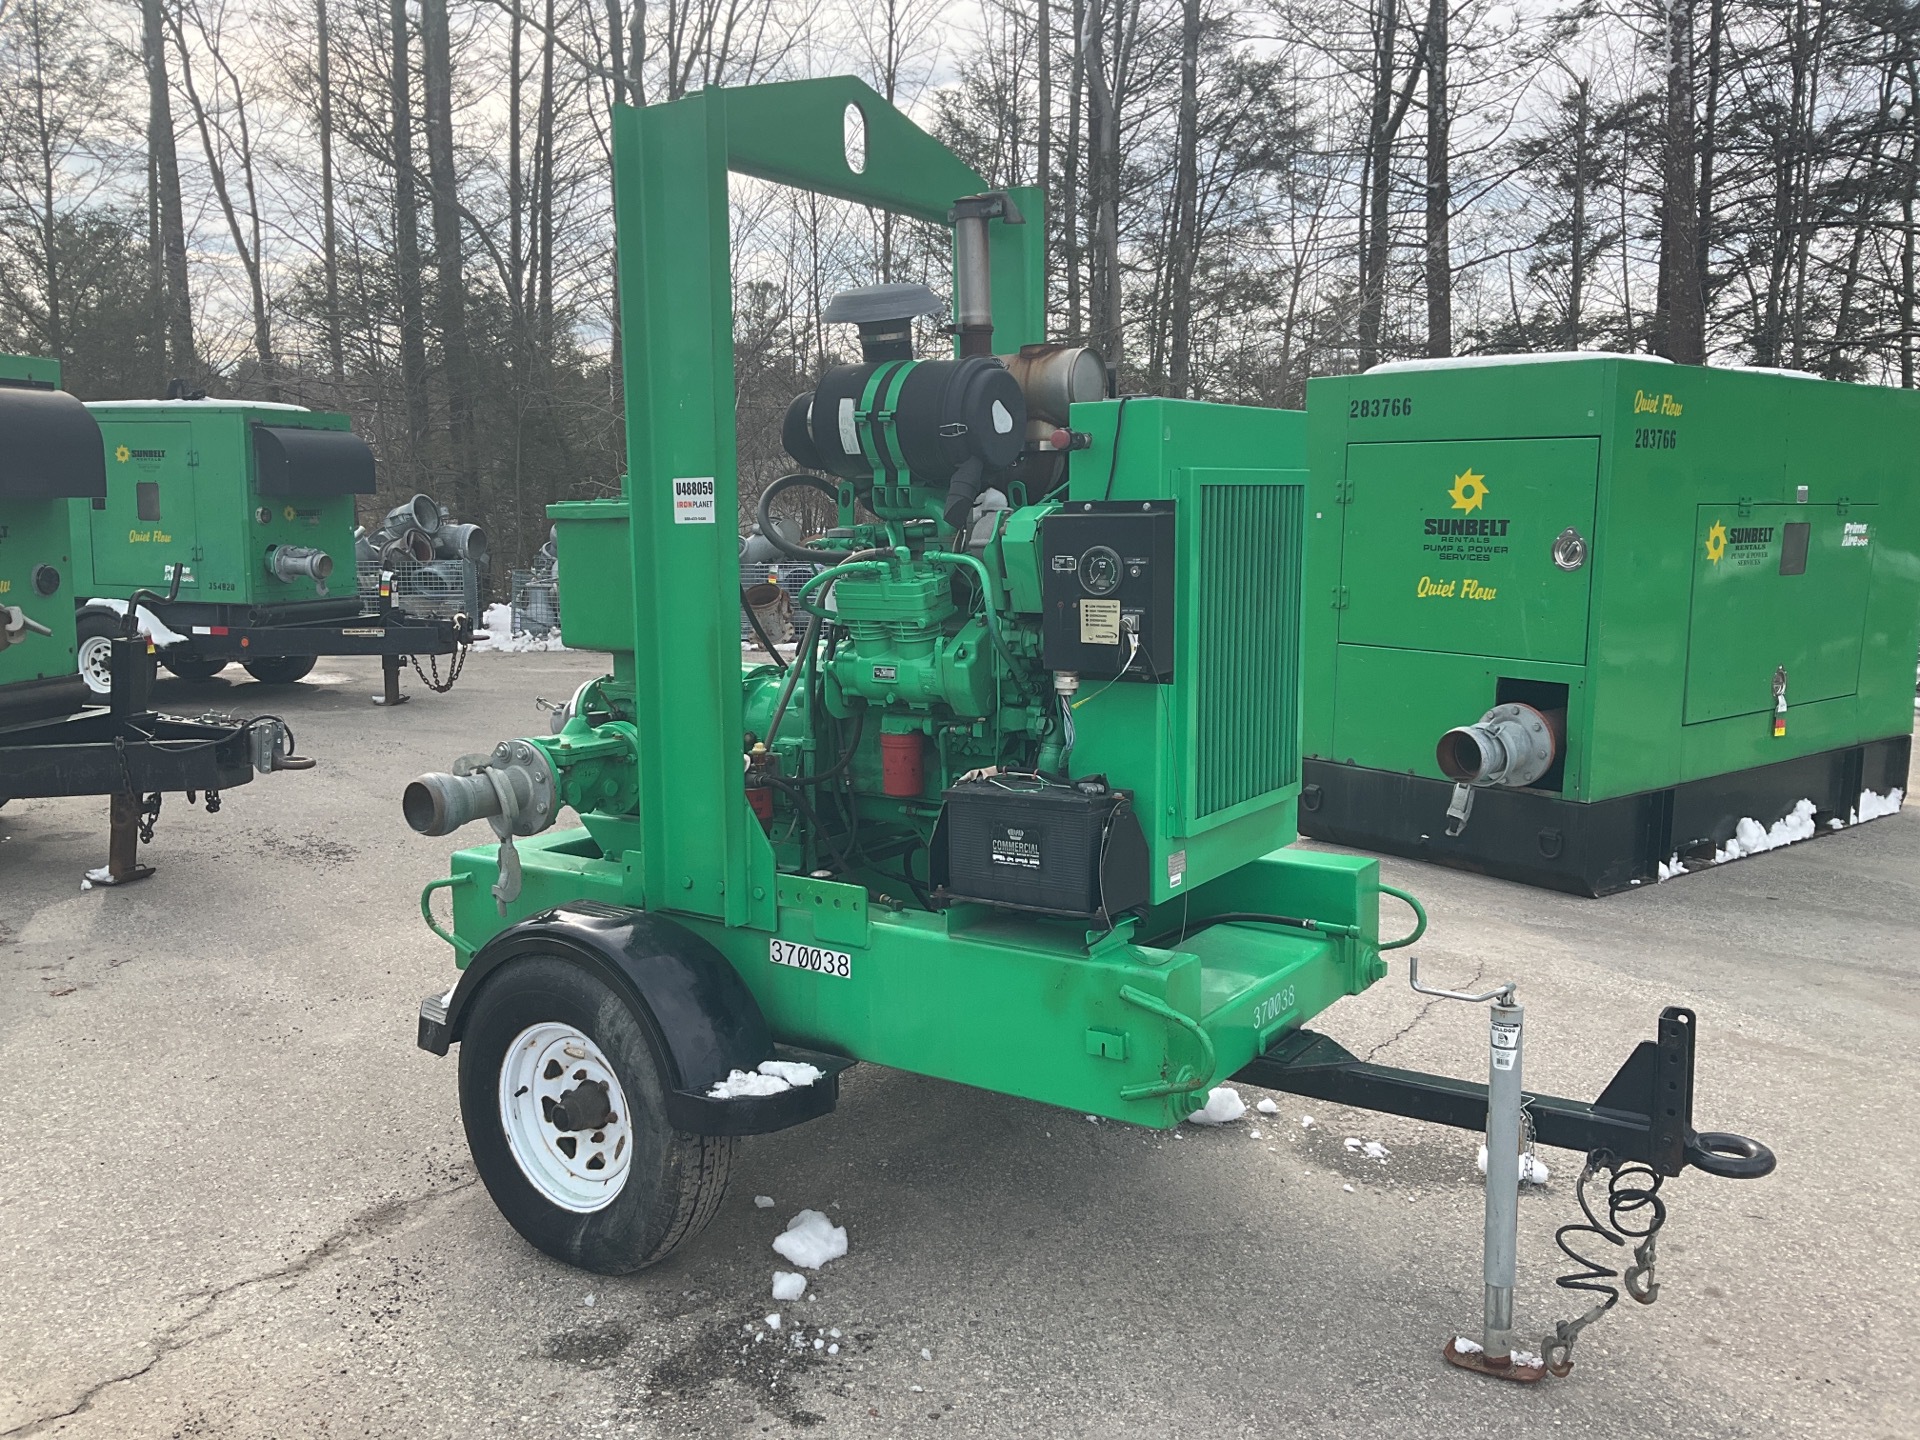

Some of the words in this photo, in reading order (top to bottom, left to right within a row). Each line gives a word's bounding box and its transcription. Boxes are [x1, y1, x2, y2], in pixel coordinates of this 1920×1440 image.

[1349, 397, 1412, 418] 283766
[1633, 389, 1660, 414] Quiet
[1660, 393, 1683, 417] Flow
[1635, 428, 1677, 450] 283766
[131, 449, 166, 458] SUNBELT
[675, 481, 714, 496] U488059
[1423, 518, 1511, 537] SUNBELT
[1729, 527, 1775, 544] SUNBELT
[128, 529, 151, 544] Quiet
[152, 529, 172, 543] Flow
[1440, 536, 1491, 544] RENTALS
[1423, 544, 1454, 552] PUMP
[1456, 545, 1465, 553] &
[1467, 545, 1509, 554] POWER
[1735, 543, 1767, 551] RENTALS
[1439, 553, 1491, 562] SERVICES
[1416, 575, 1456, 598] Quiet
[1460, 578, 1497, 601] Flow
[992, 839, 1040, 855] COMMERCIAL
[771, 940, 850, 977] 370038
[1253, 984, 1295, 1029] 370038
